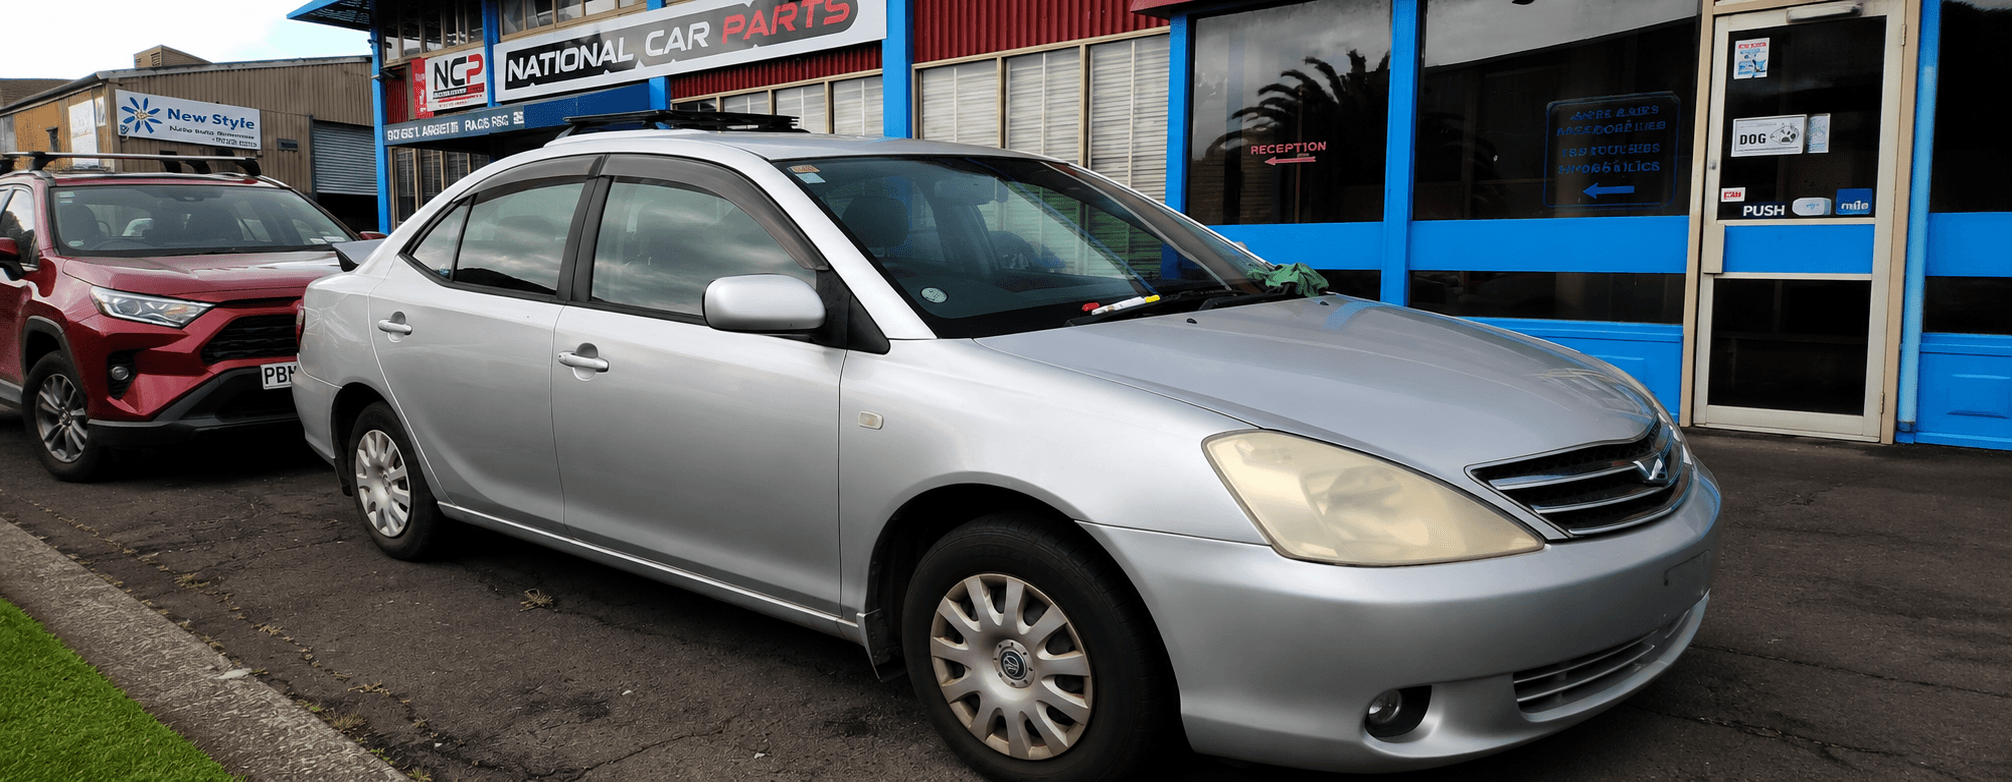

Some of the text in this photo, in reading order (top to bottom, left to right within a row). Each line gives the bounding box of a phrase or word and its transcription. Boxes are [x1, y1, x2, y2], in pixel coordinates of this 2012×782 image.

[507, 0, 850, 82] NATIONAL CAR PARTS
[434, 53, 483, 90] NCP
[167, 107, 255, 130] New Style
[1739, 132, 1767, 145] DOG
[1250, 141, 1327, 155] RECEPTION
[1742, 204, 1786, 217] PUSH
